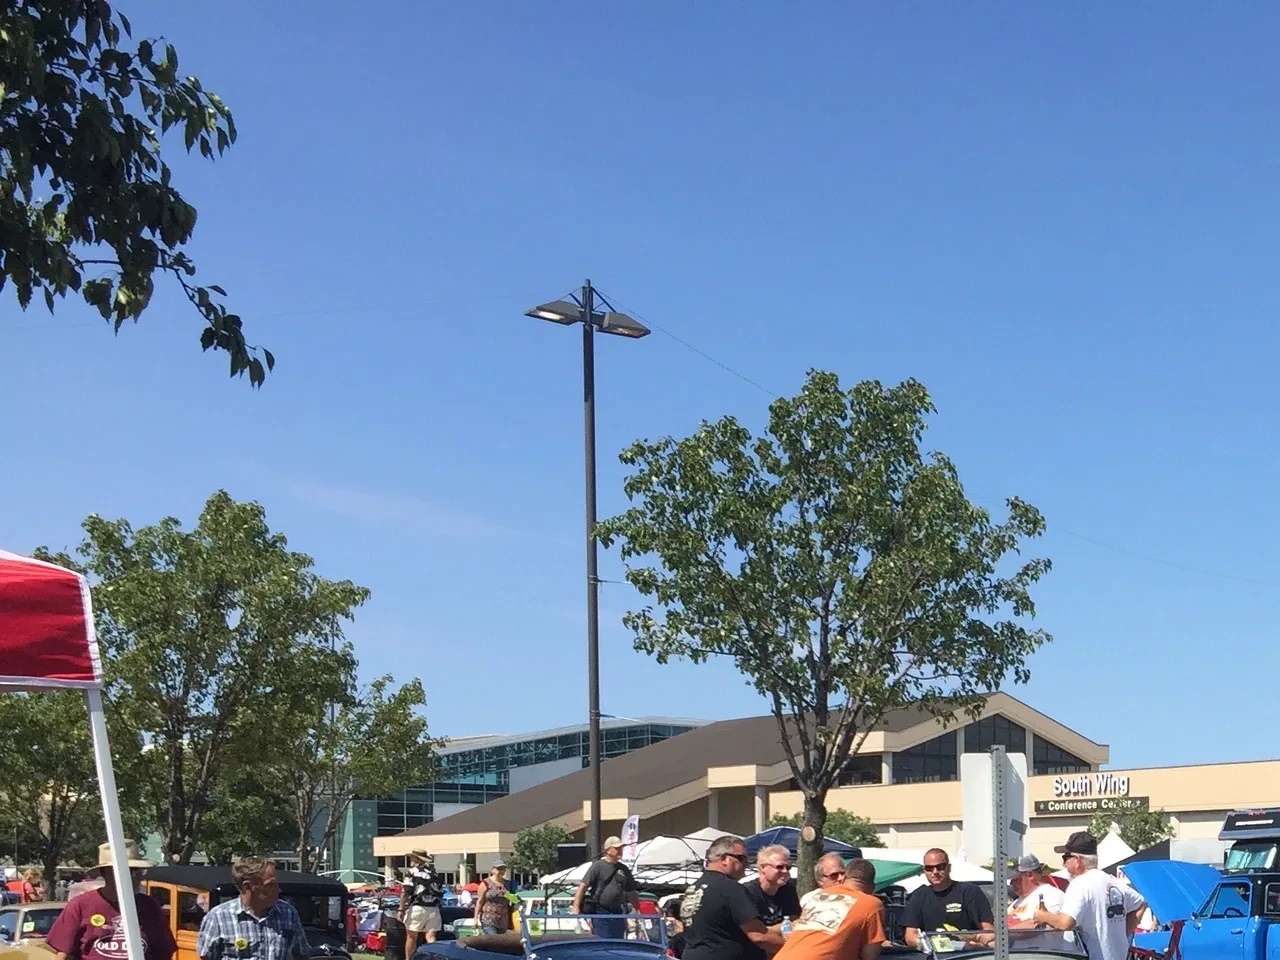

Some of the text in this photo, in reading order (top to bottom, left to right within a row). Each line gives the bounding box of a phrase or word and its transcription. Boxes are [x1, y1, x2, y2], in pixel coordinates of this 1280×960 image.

[1053, 774, 1130, 796] South Wing
[1048, 799, 1132, 811] Conference Ceer
[97, 941, 119, 951] OLD
